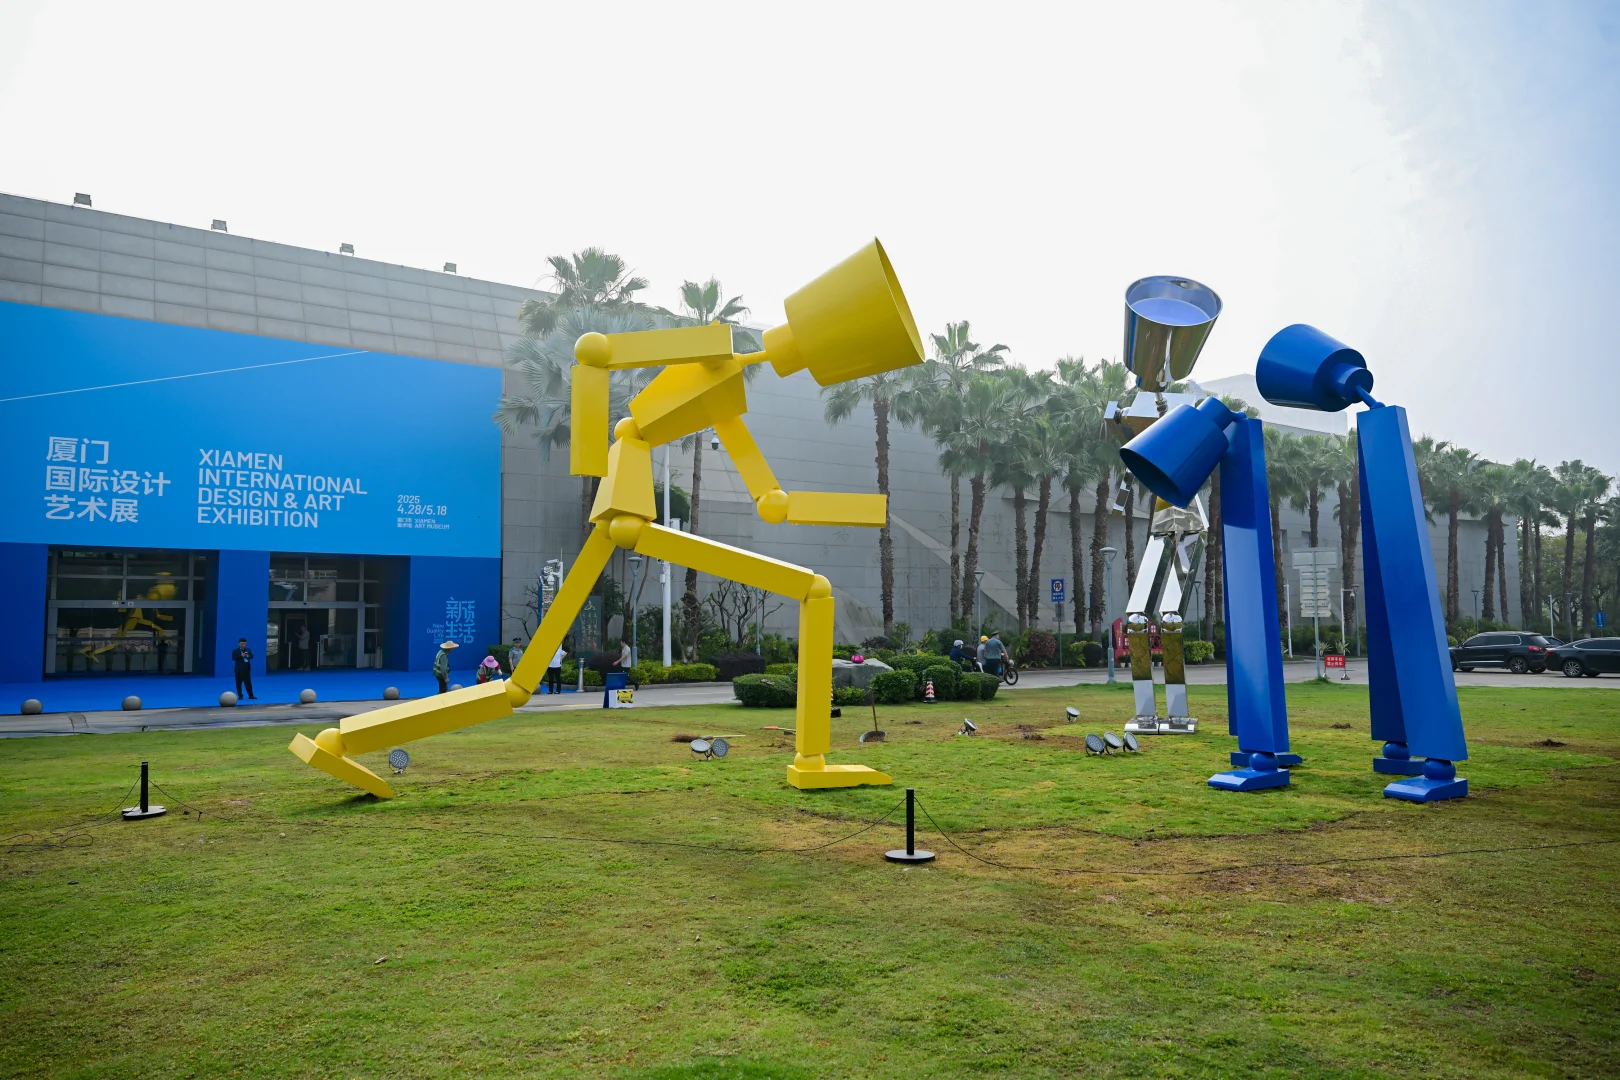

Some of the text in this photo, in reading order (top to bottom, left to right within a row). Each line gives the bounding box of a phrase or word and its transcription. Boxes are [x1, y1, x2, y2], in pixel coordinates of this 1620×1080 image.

[46, 436, 110, 465] 厦门
[199, 449, 283, 471] XIAMEN
[45, 465, 171, 497] 国际设计
[198, 468, 368, 495] INTERNATIONAL
[44, 493, 139, 524] 艺术展
[198, 488, 345, 511] DESIGN & ART
[397, 495, 420, 504] 2025
[397, 504, 447, 515] 4.28/5.18
[197, 507, 319, 528] EXHIBITION
[446, 596, 476, 622] 新质
[446, 620, 476, 643] 生活
